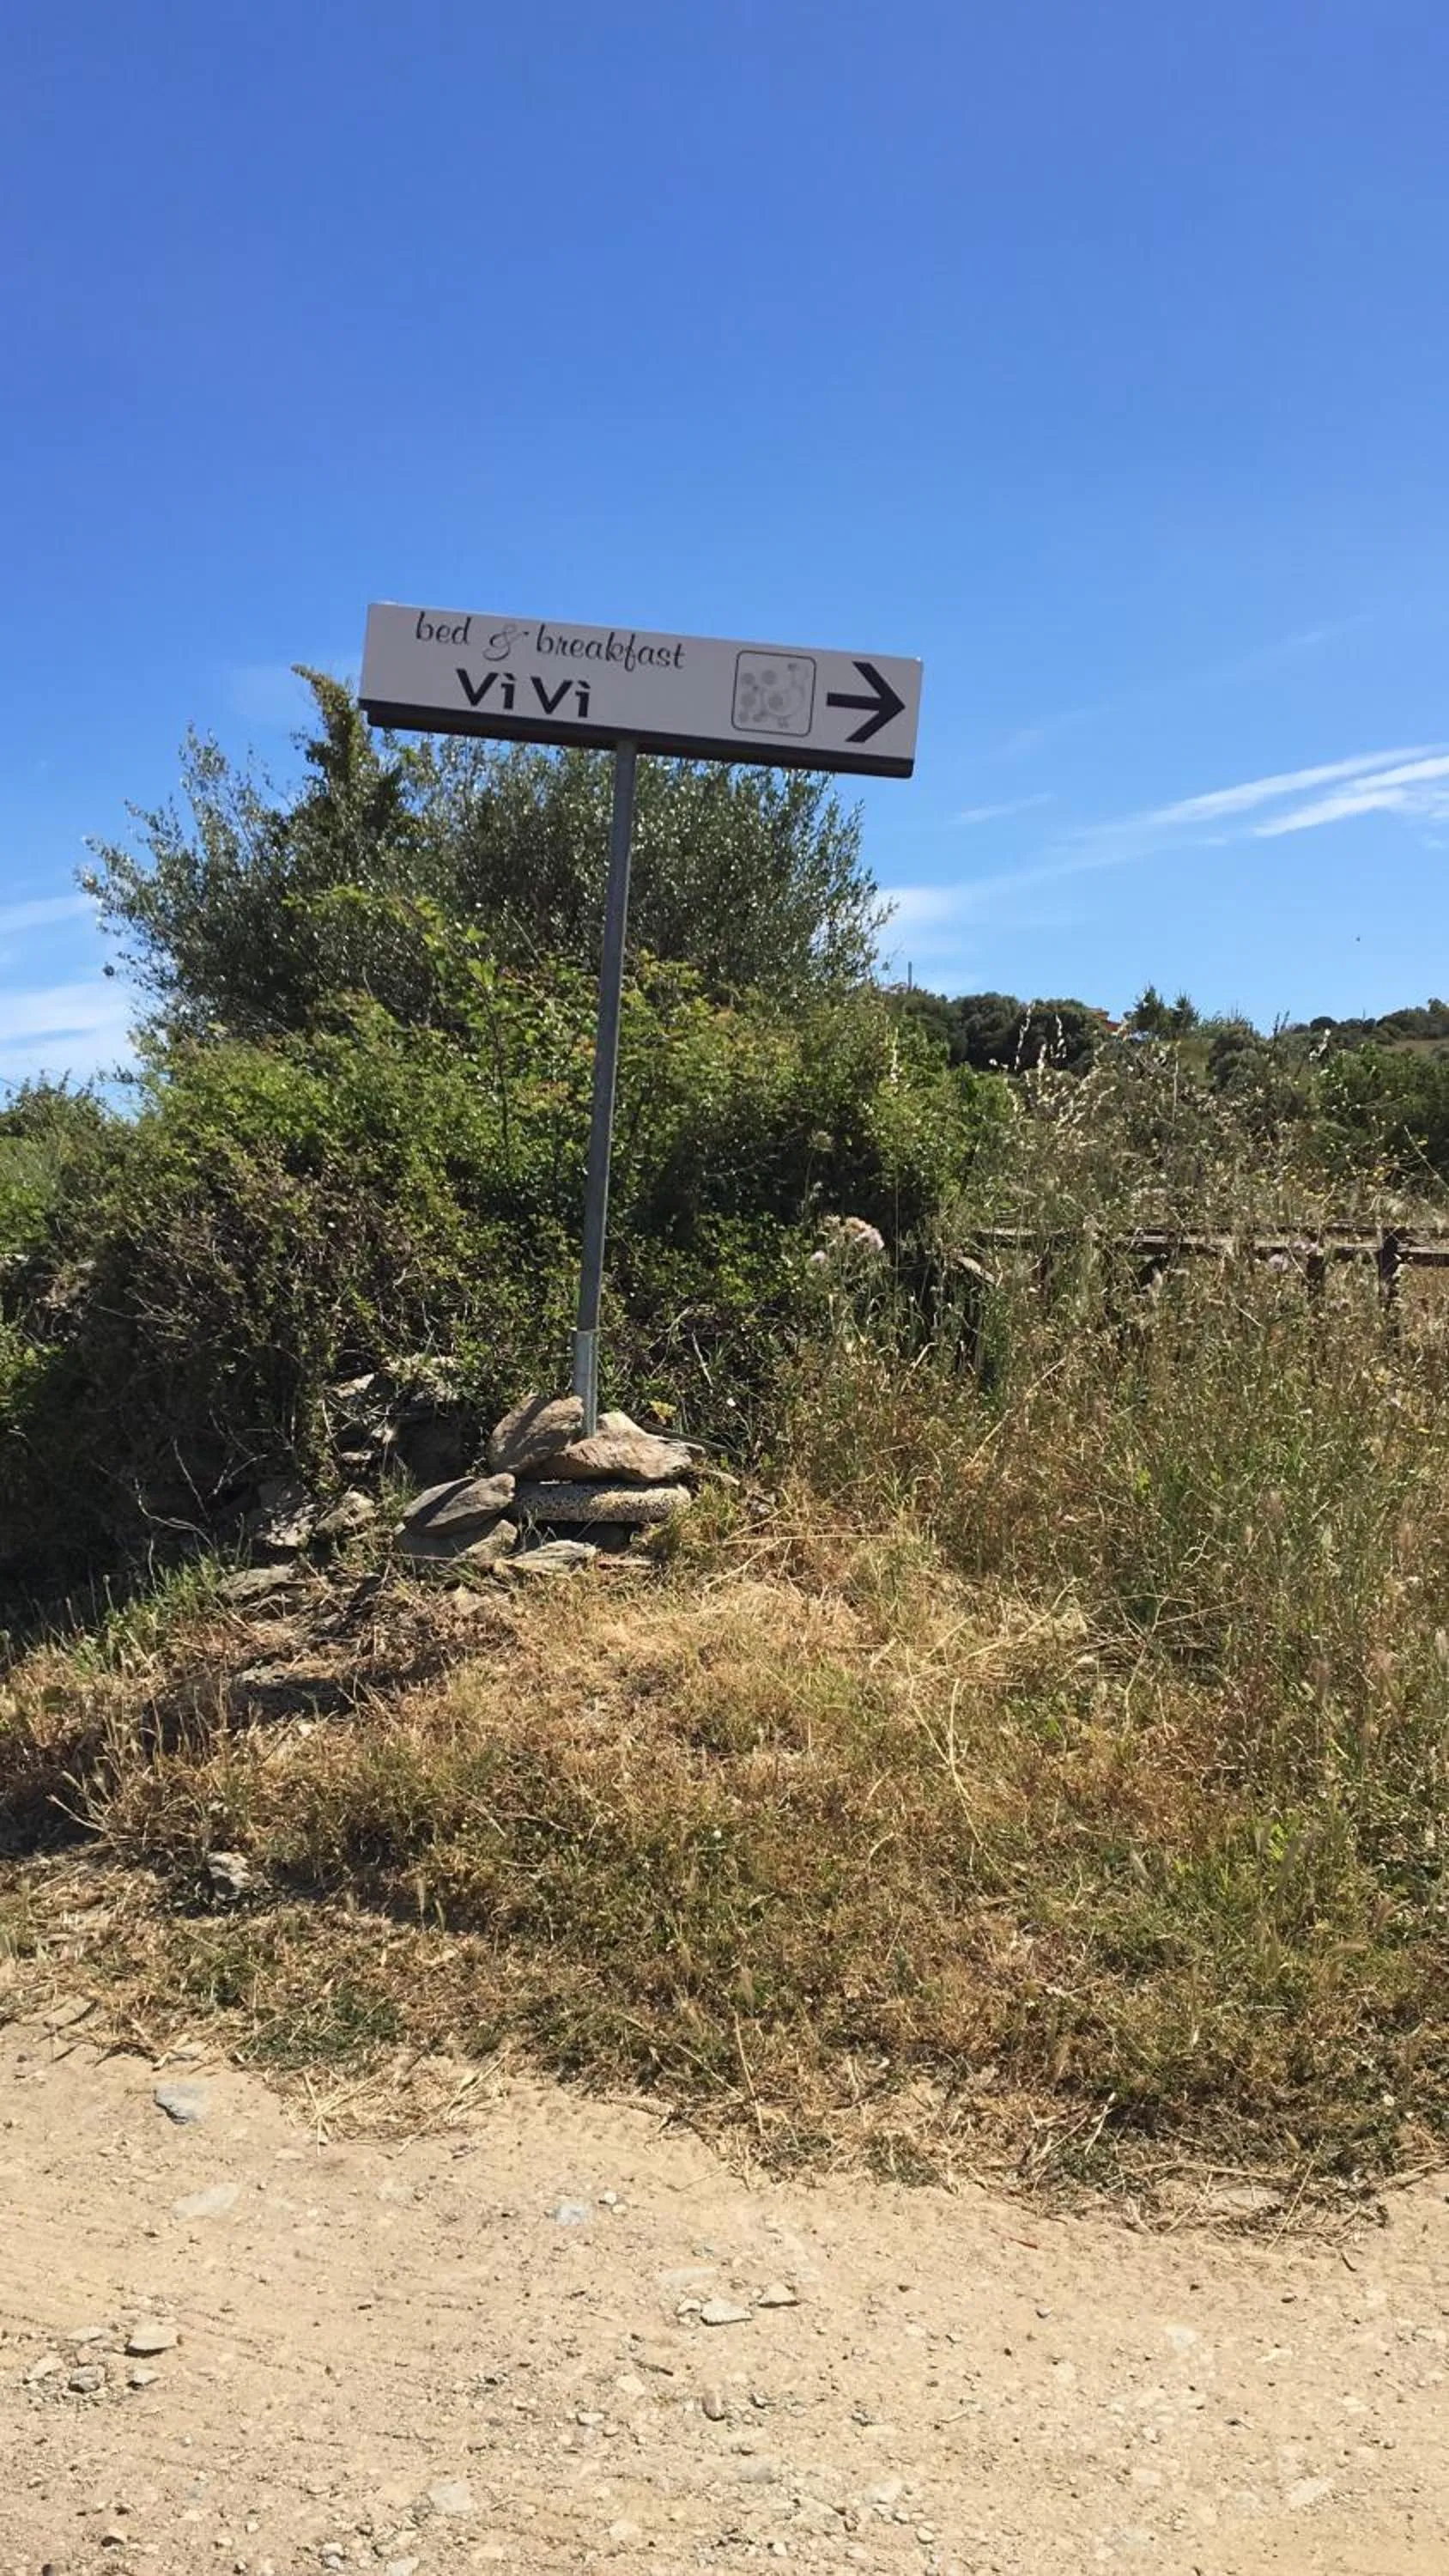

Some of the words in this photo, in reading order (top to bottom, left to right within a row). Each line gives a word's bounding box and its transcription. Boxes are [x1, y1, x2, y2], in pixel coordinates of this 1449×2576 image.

[415, 611, 470, 646] bed
[482, 623, 530, 661] &
[537, 624, 685, 671] breakfast
